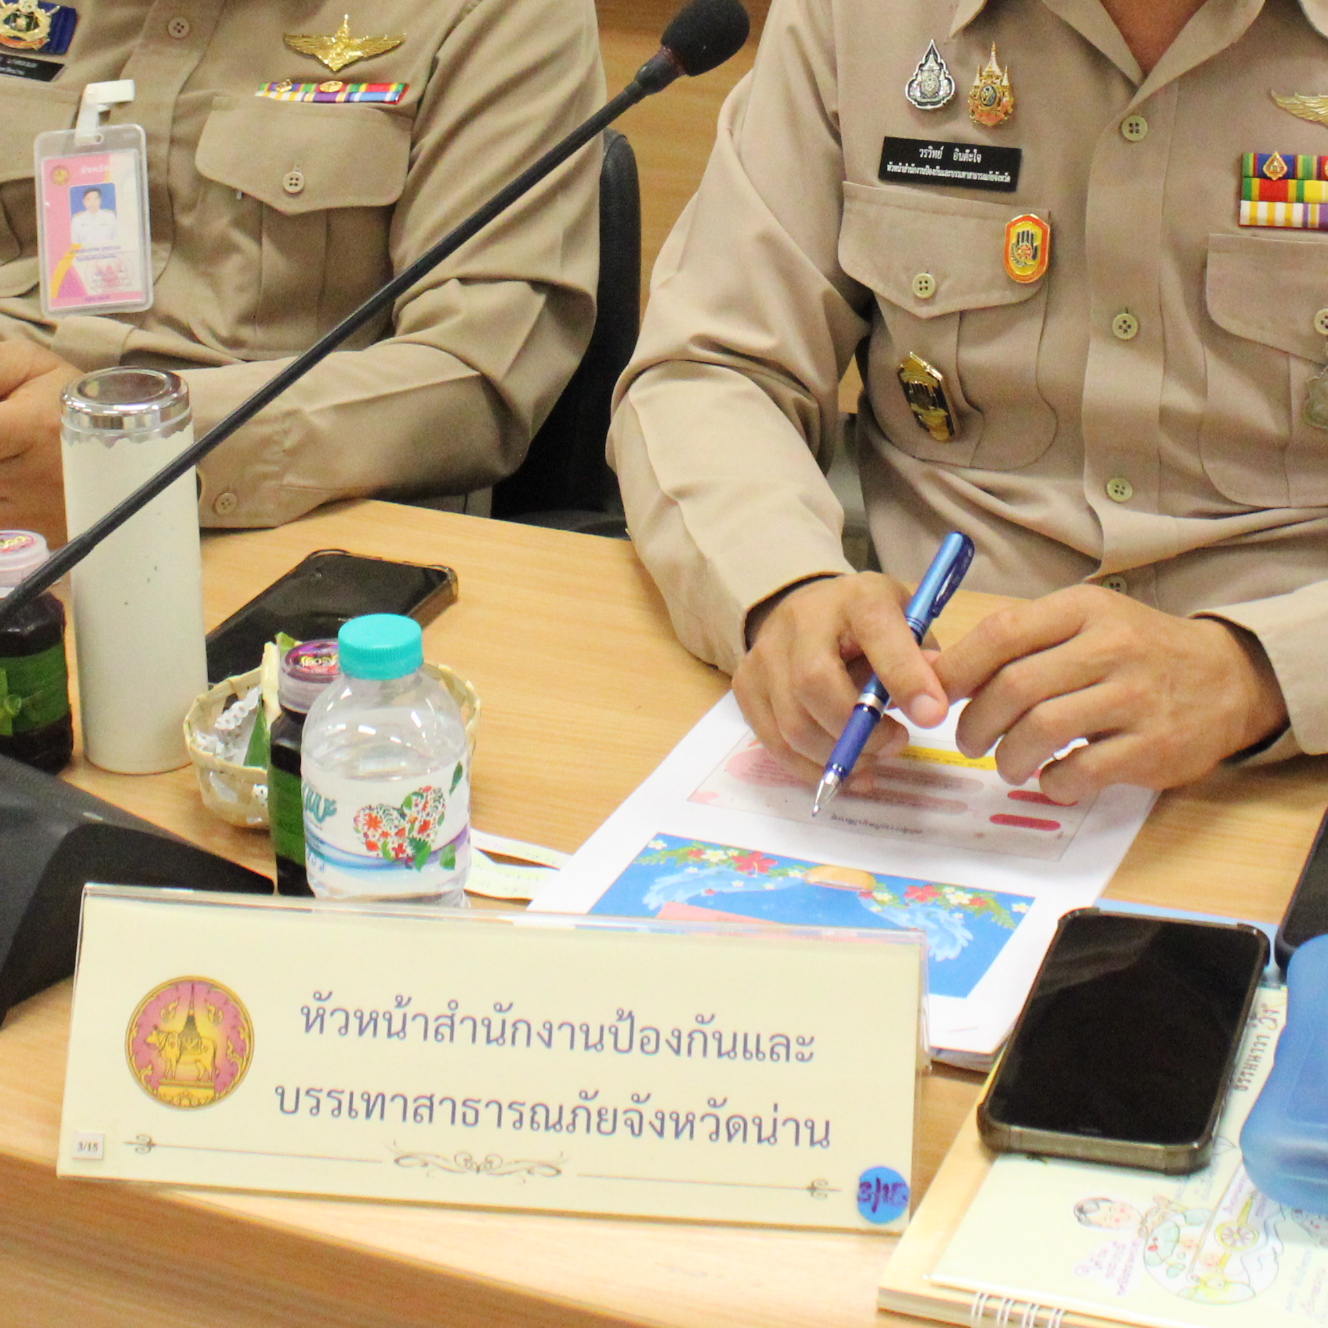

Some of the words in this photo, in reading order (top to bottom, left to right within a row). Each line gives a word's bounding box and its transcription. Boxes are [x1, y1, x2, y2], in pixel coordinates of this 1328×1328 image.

[299, 989, 817, 1067] หัวหน้าสำนักงานป้องกันและ
[76, 1140, 99, 1152] 3/15
[273, 1077, 832, 1151] บรรเทาสาธารณภัยจังหวัดน่าน
